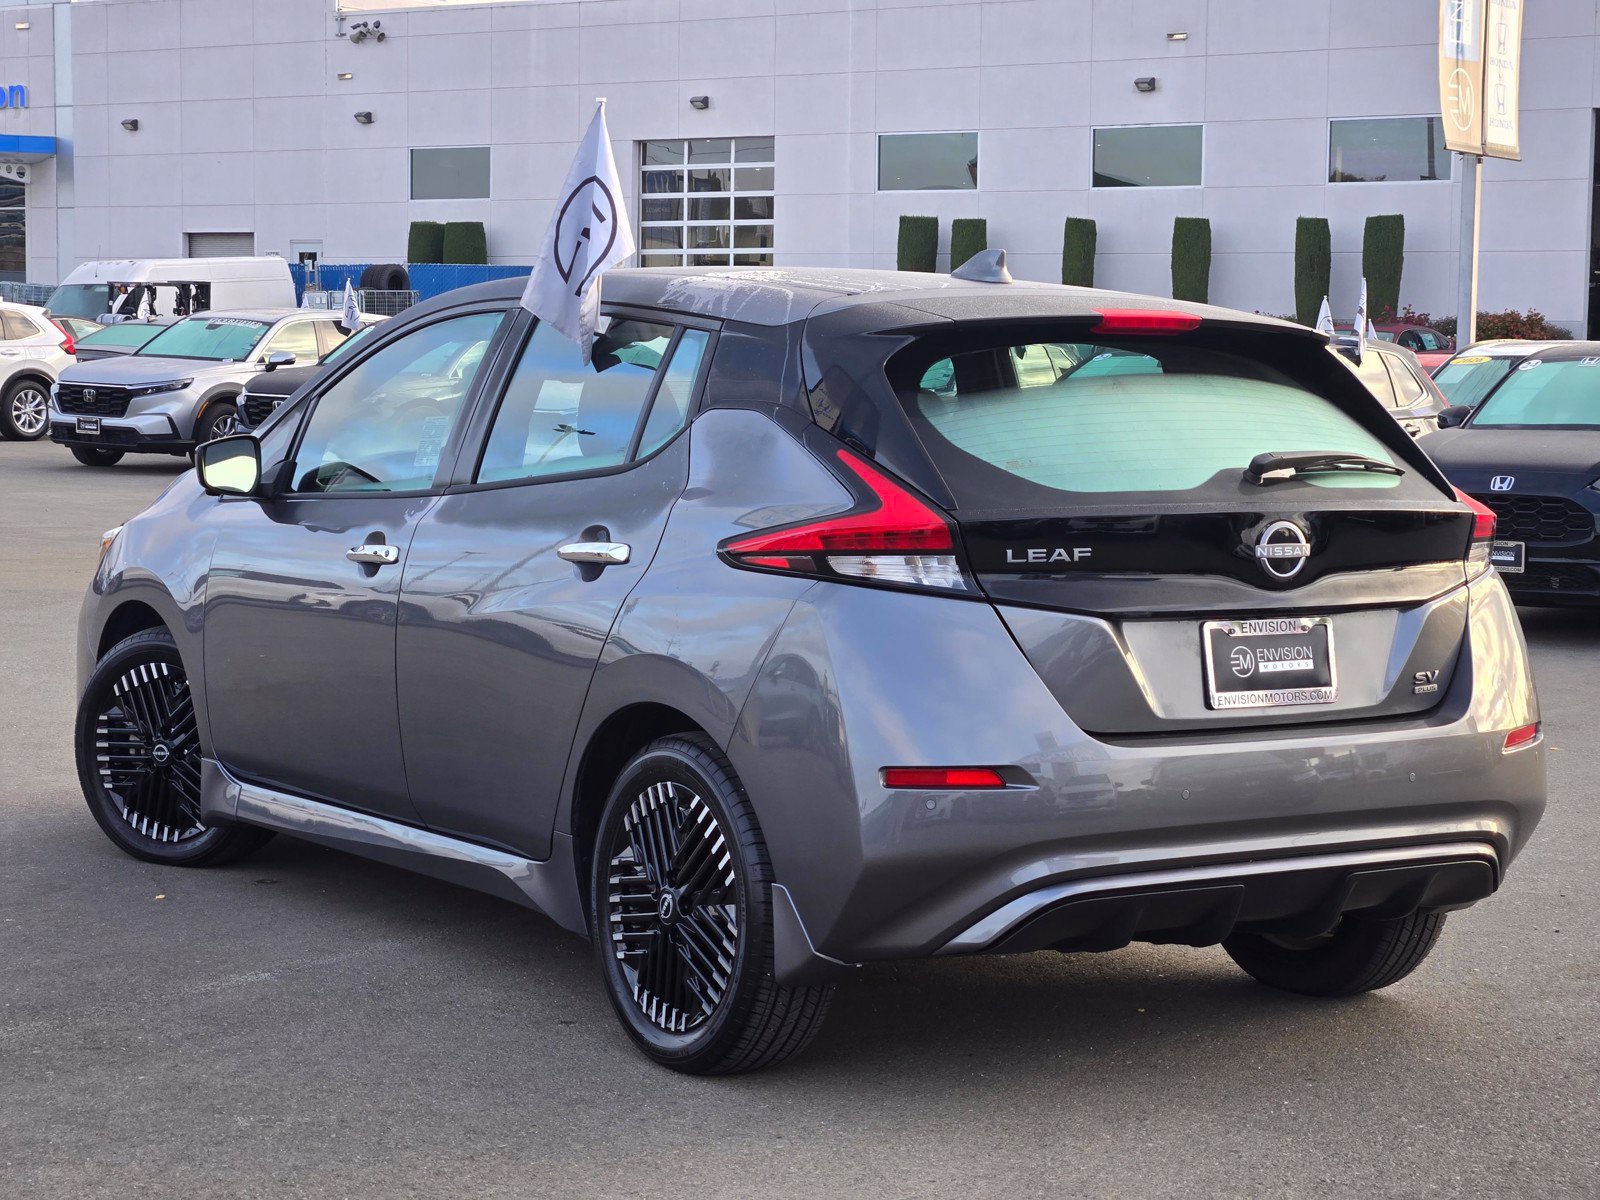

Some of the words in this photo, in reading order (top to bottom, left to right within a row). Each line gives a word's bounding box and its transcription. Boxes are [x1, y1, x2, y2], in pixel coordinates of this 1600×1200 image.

[1006, 547, 1092, 563] LEAF
[1257, 546, 1310, 557] NISSAN
[1241, 620, 1296, 634] ENVISION
[1256, 646, 1313, 662] ENVISION
[1263, 662, 1310, 670] MOTORS
[1414, 670, 1439, 684] SV
[1217, 690, 1333, 707] ENVISIONMOTORS.COM
